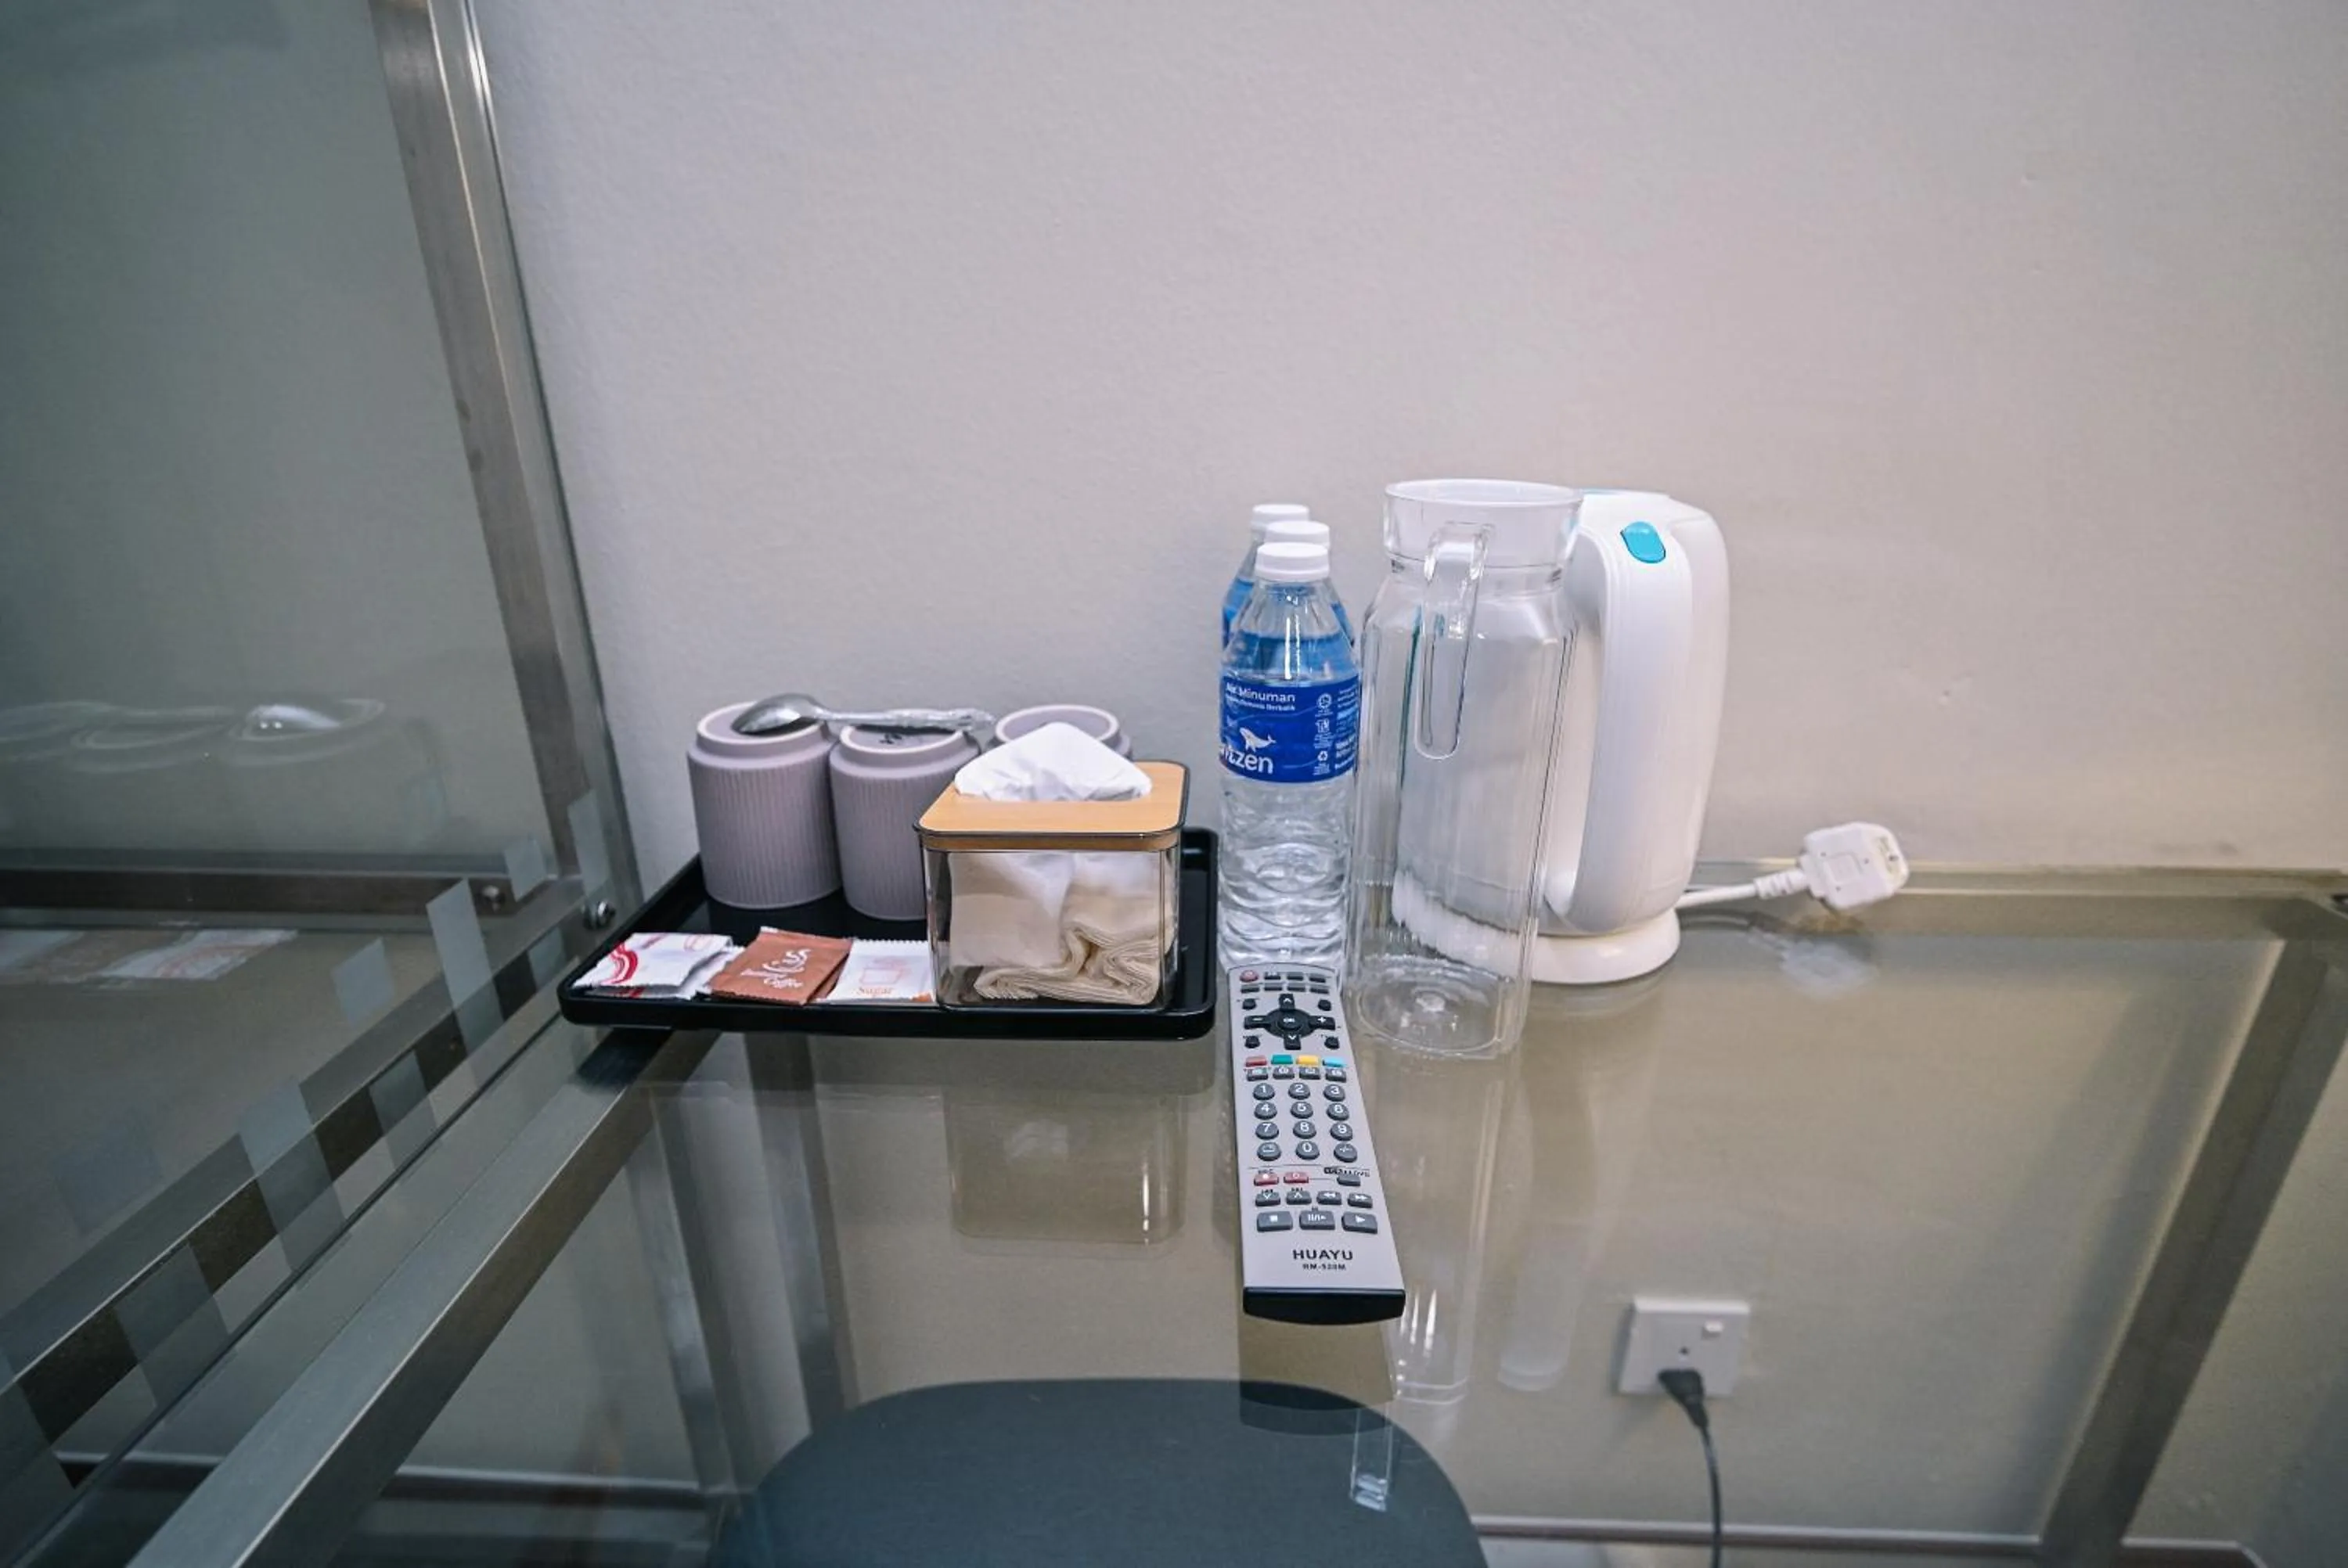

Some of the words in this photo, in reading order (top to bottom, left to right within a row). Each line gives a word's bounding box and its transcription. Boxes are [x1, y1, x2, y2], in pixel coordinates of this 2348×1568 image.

[1260, 1084, 1266, 1093] 1
[1295, 1084, 1305, 1093] 2
[1331, 1085, 1340, 1095] 3
[1261, 1103, 1269, 1112] 4
[1297, 1102, 1306, 1112] 5
[1334, 1104, 1344, 1113] 6
[1262, 1123, 1271, 1132] 7
[1300, 1122, 1309, 1132] 8
[1337, 1124, 1347, 1134] 9
[1302, 1142, 1313, 1153] 0
[1292, 1249, 1353, 1261] HUAYU
